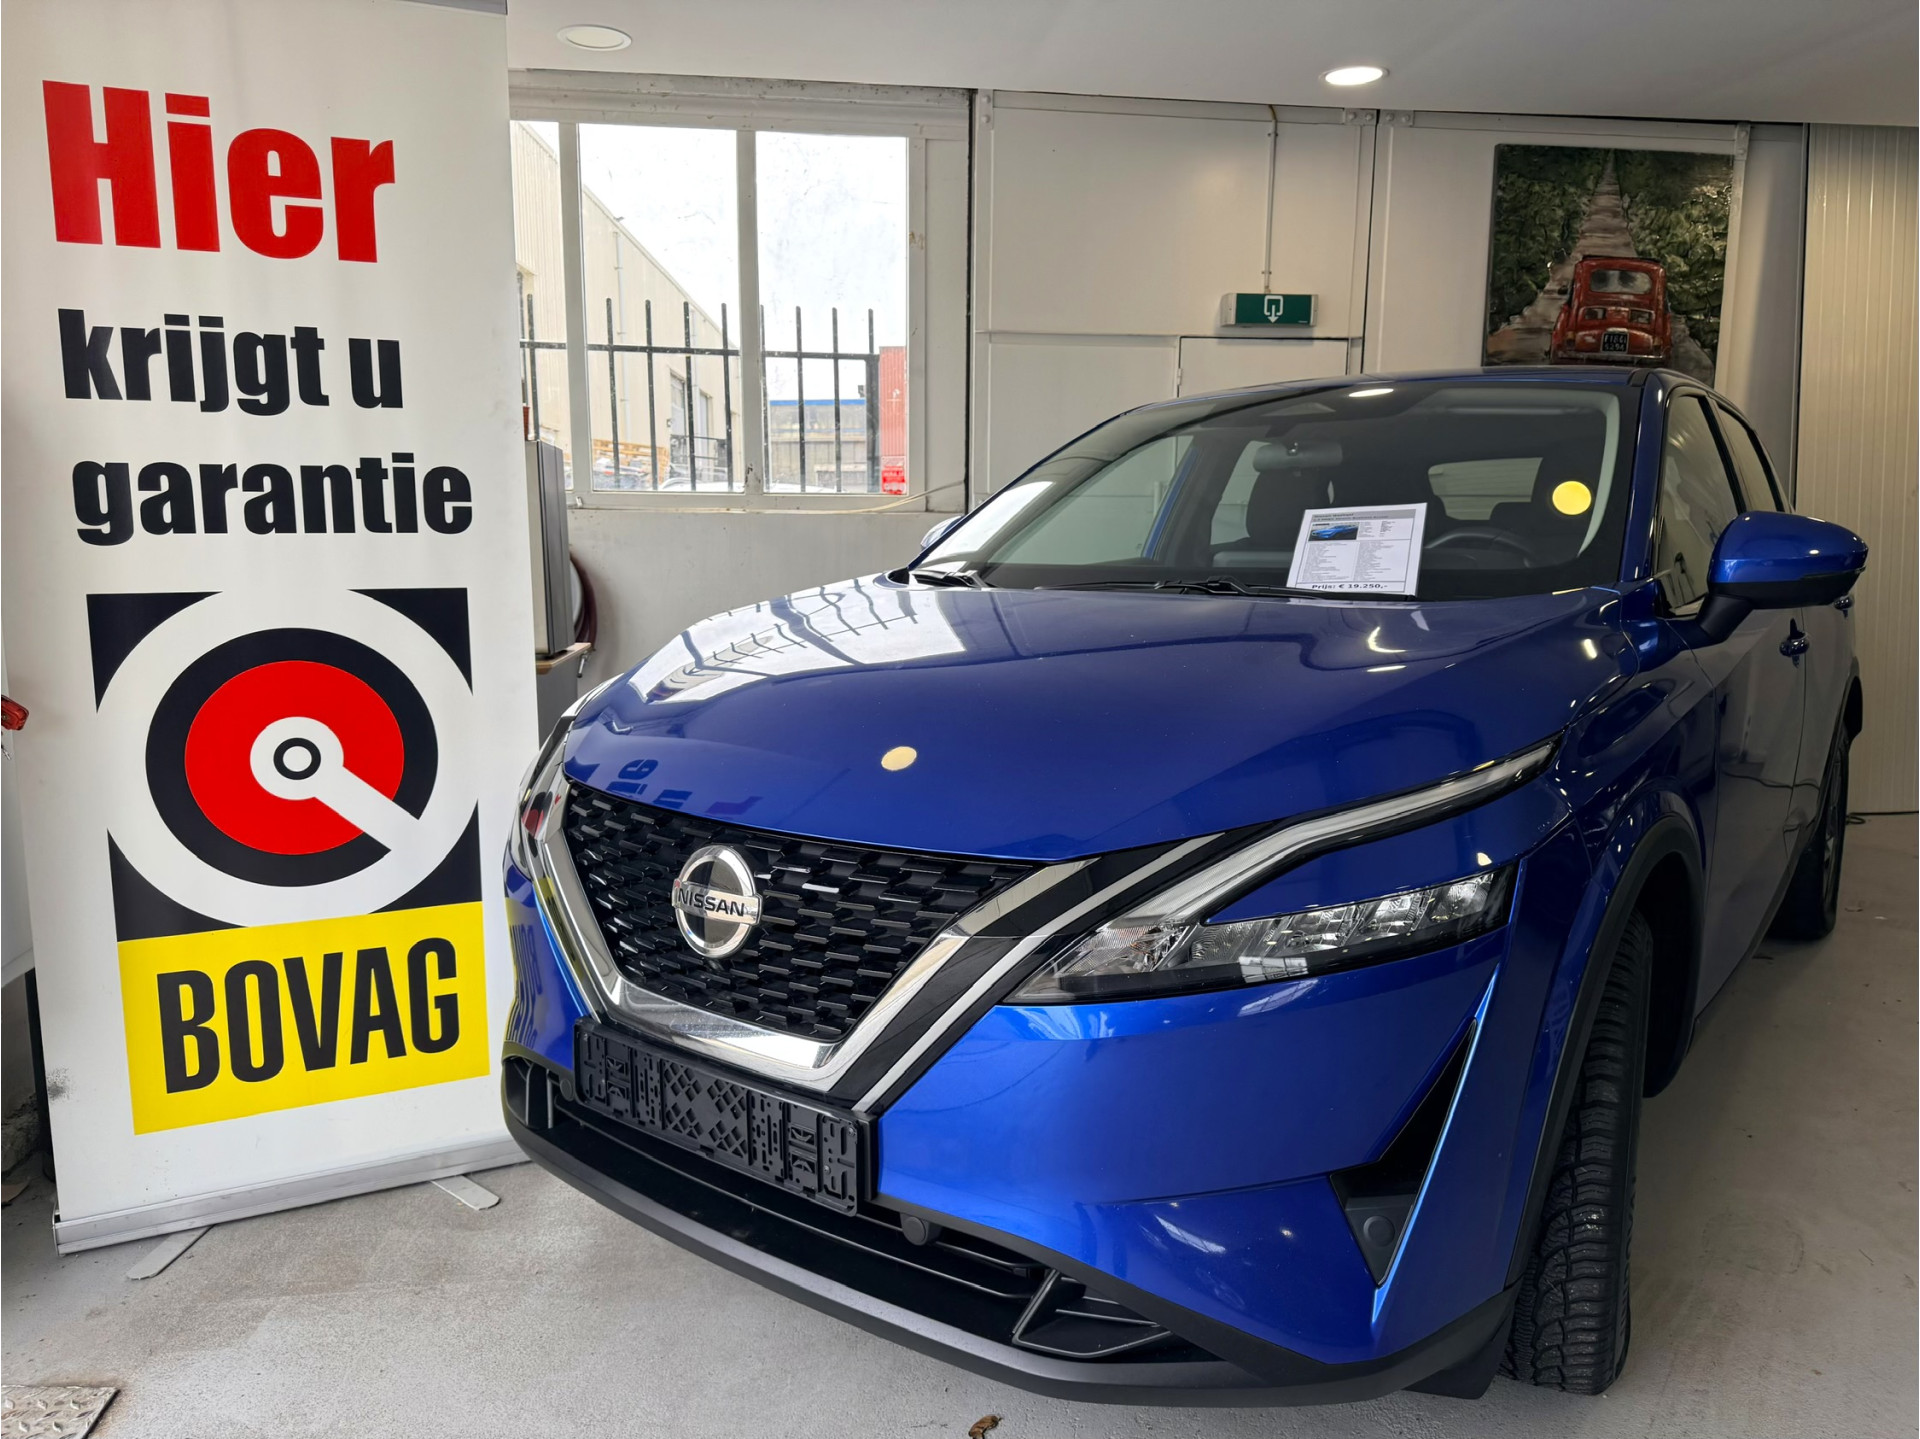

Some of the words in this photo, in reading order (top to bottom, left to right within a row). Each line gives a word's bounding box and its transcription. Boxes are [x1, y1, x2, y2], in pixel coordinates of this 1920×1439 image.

[42, 80, 396, 263] Hier
[57, 308, 330, 416] krijgt
[348, 337, 404, 409] u
[71, 452, 473, 547] garantie
[678, 889, 745, 917] NISSAN
[156, 937, 460, 1094] BOVAG
